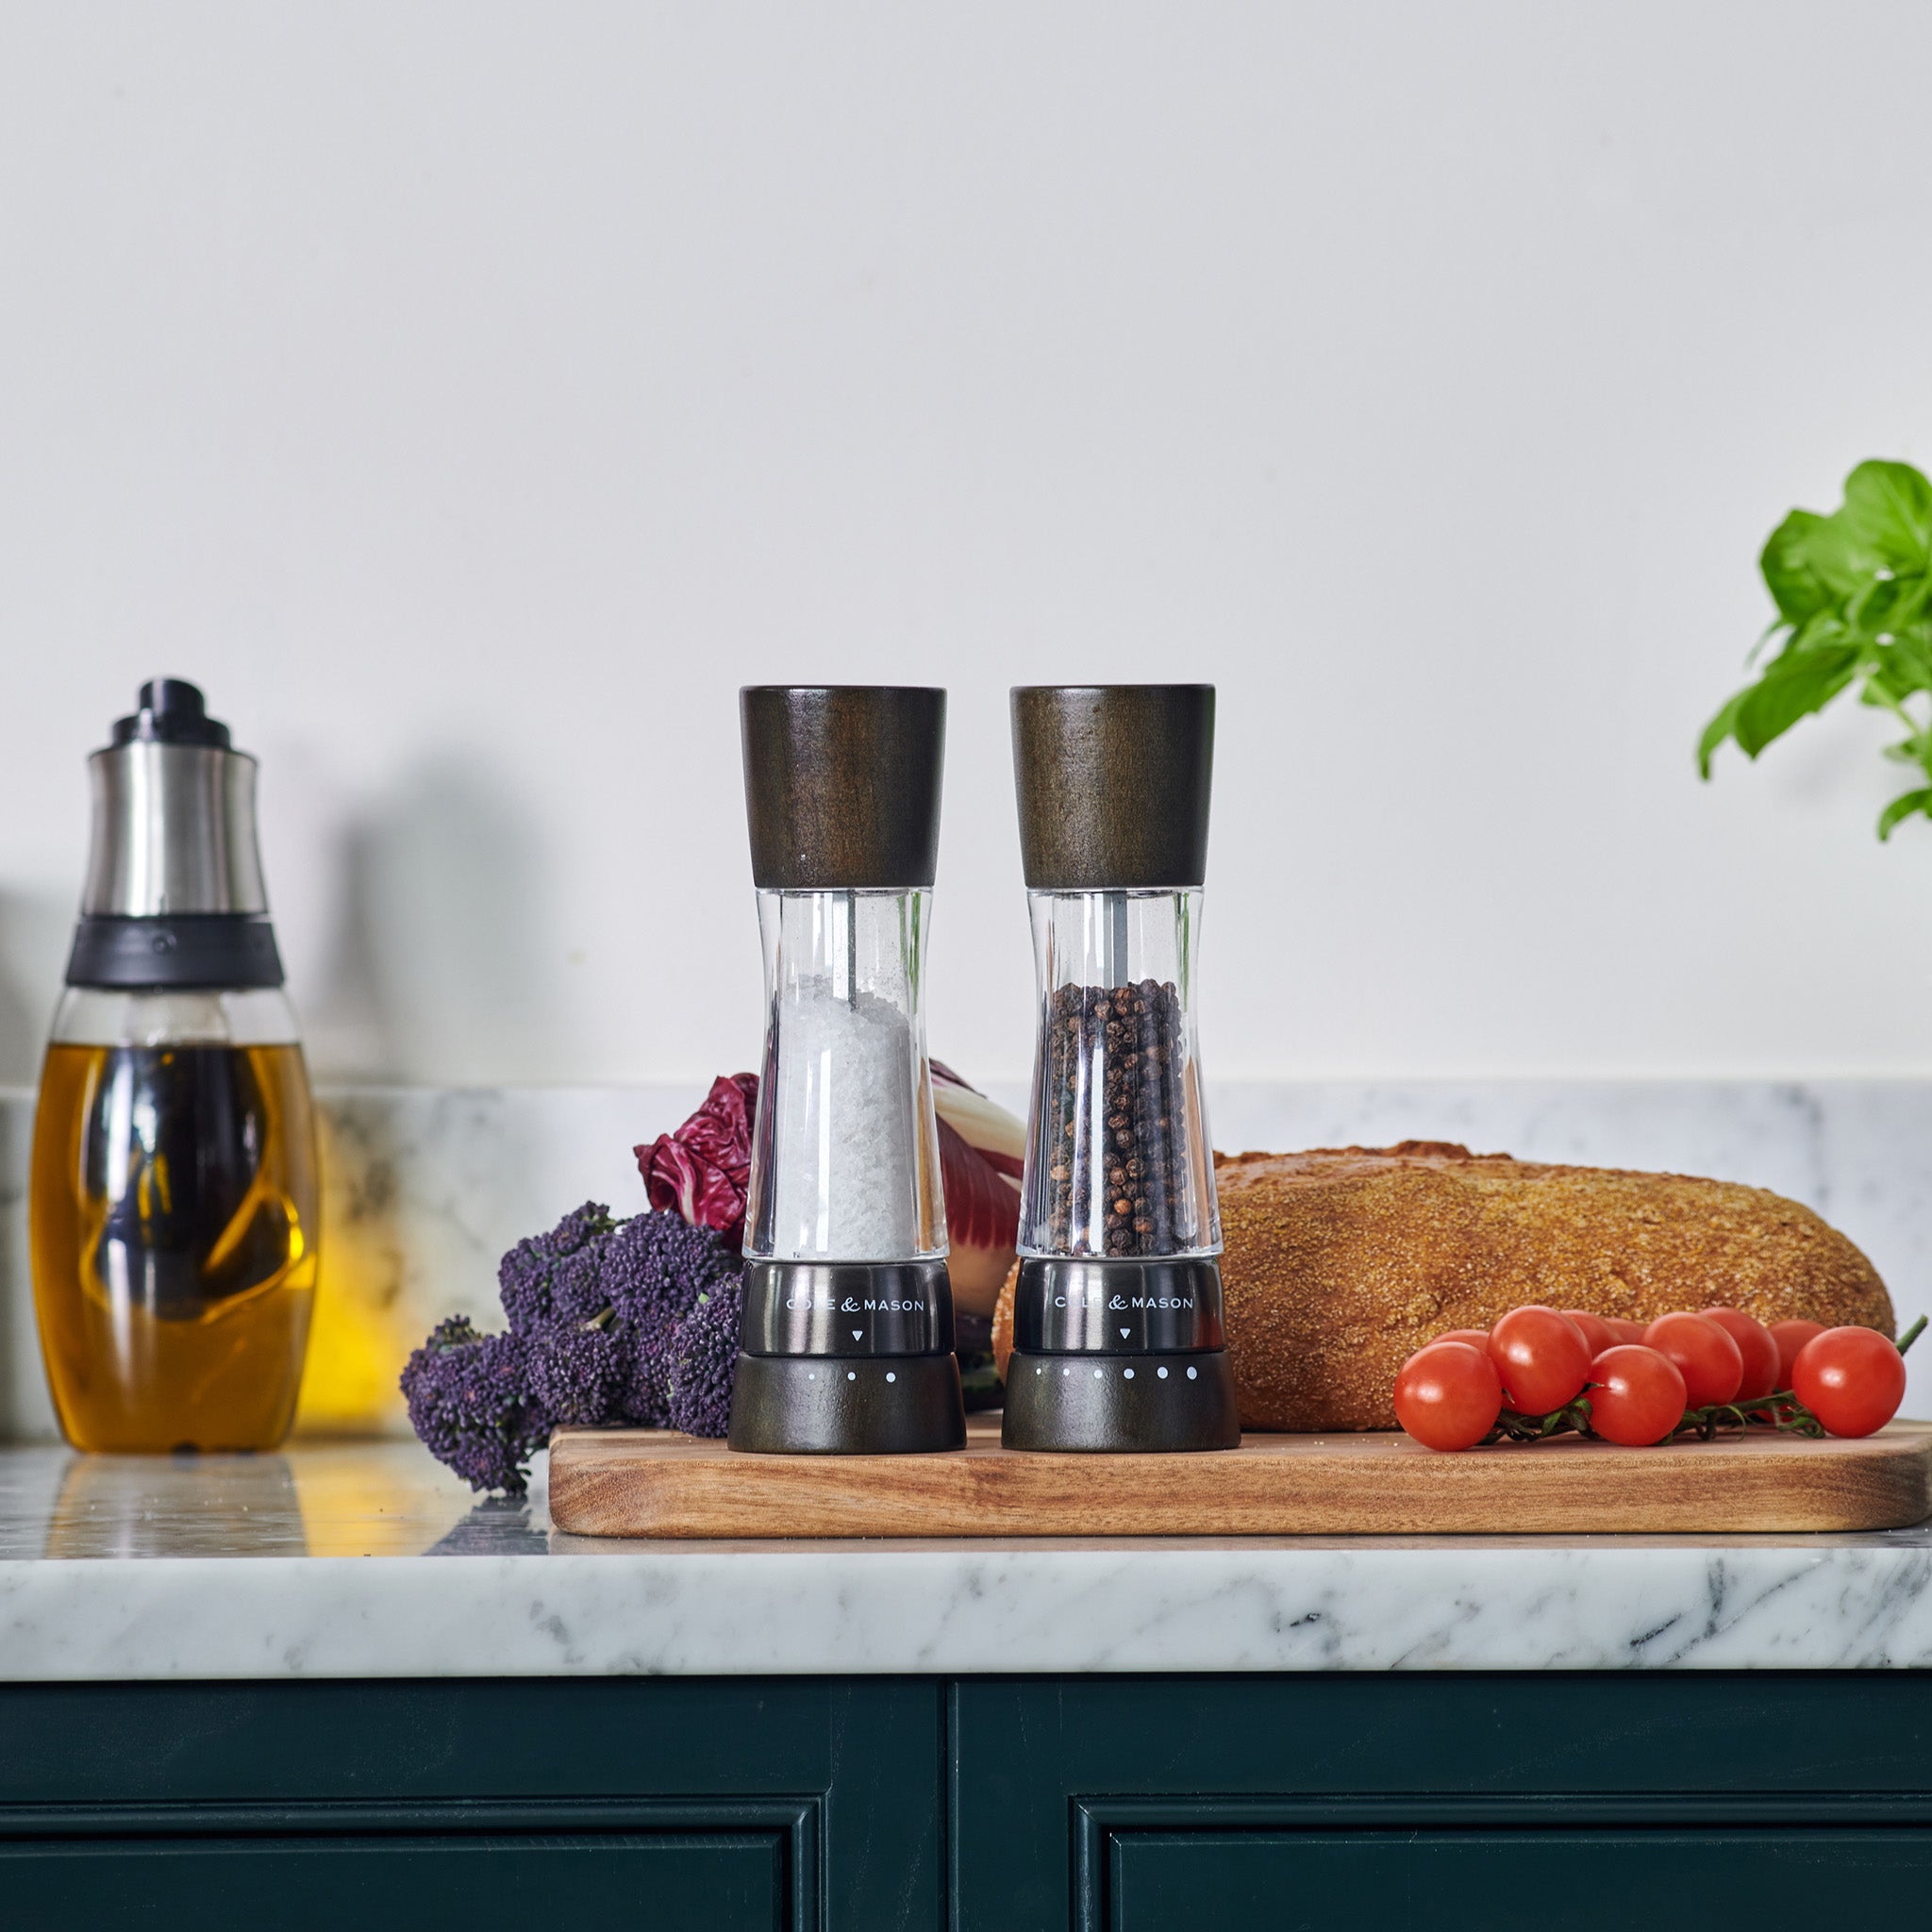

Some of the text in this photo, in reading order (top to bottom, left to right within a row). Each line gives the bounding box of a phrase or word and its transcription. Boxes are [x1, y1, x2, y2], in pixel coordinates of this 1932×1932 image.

[786, 1296, 924, 1312] COE & MASON
[1108, 1294, 1128, 1310] &
[1131, 1297, 1193, 1309] MASON
